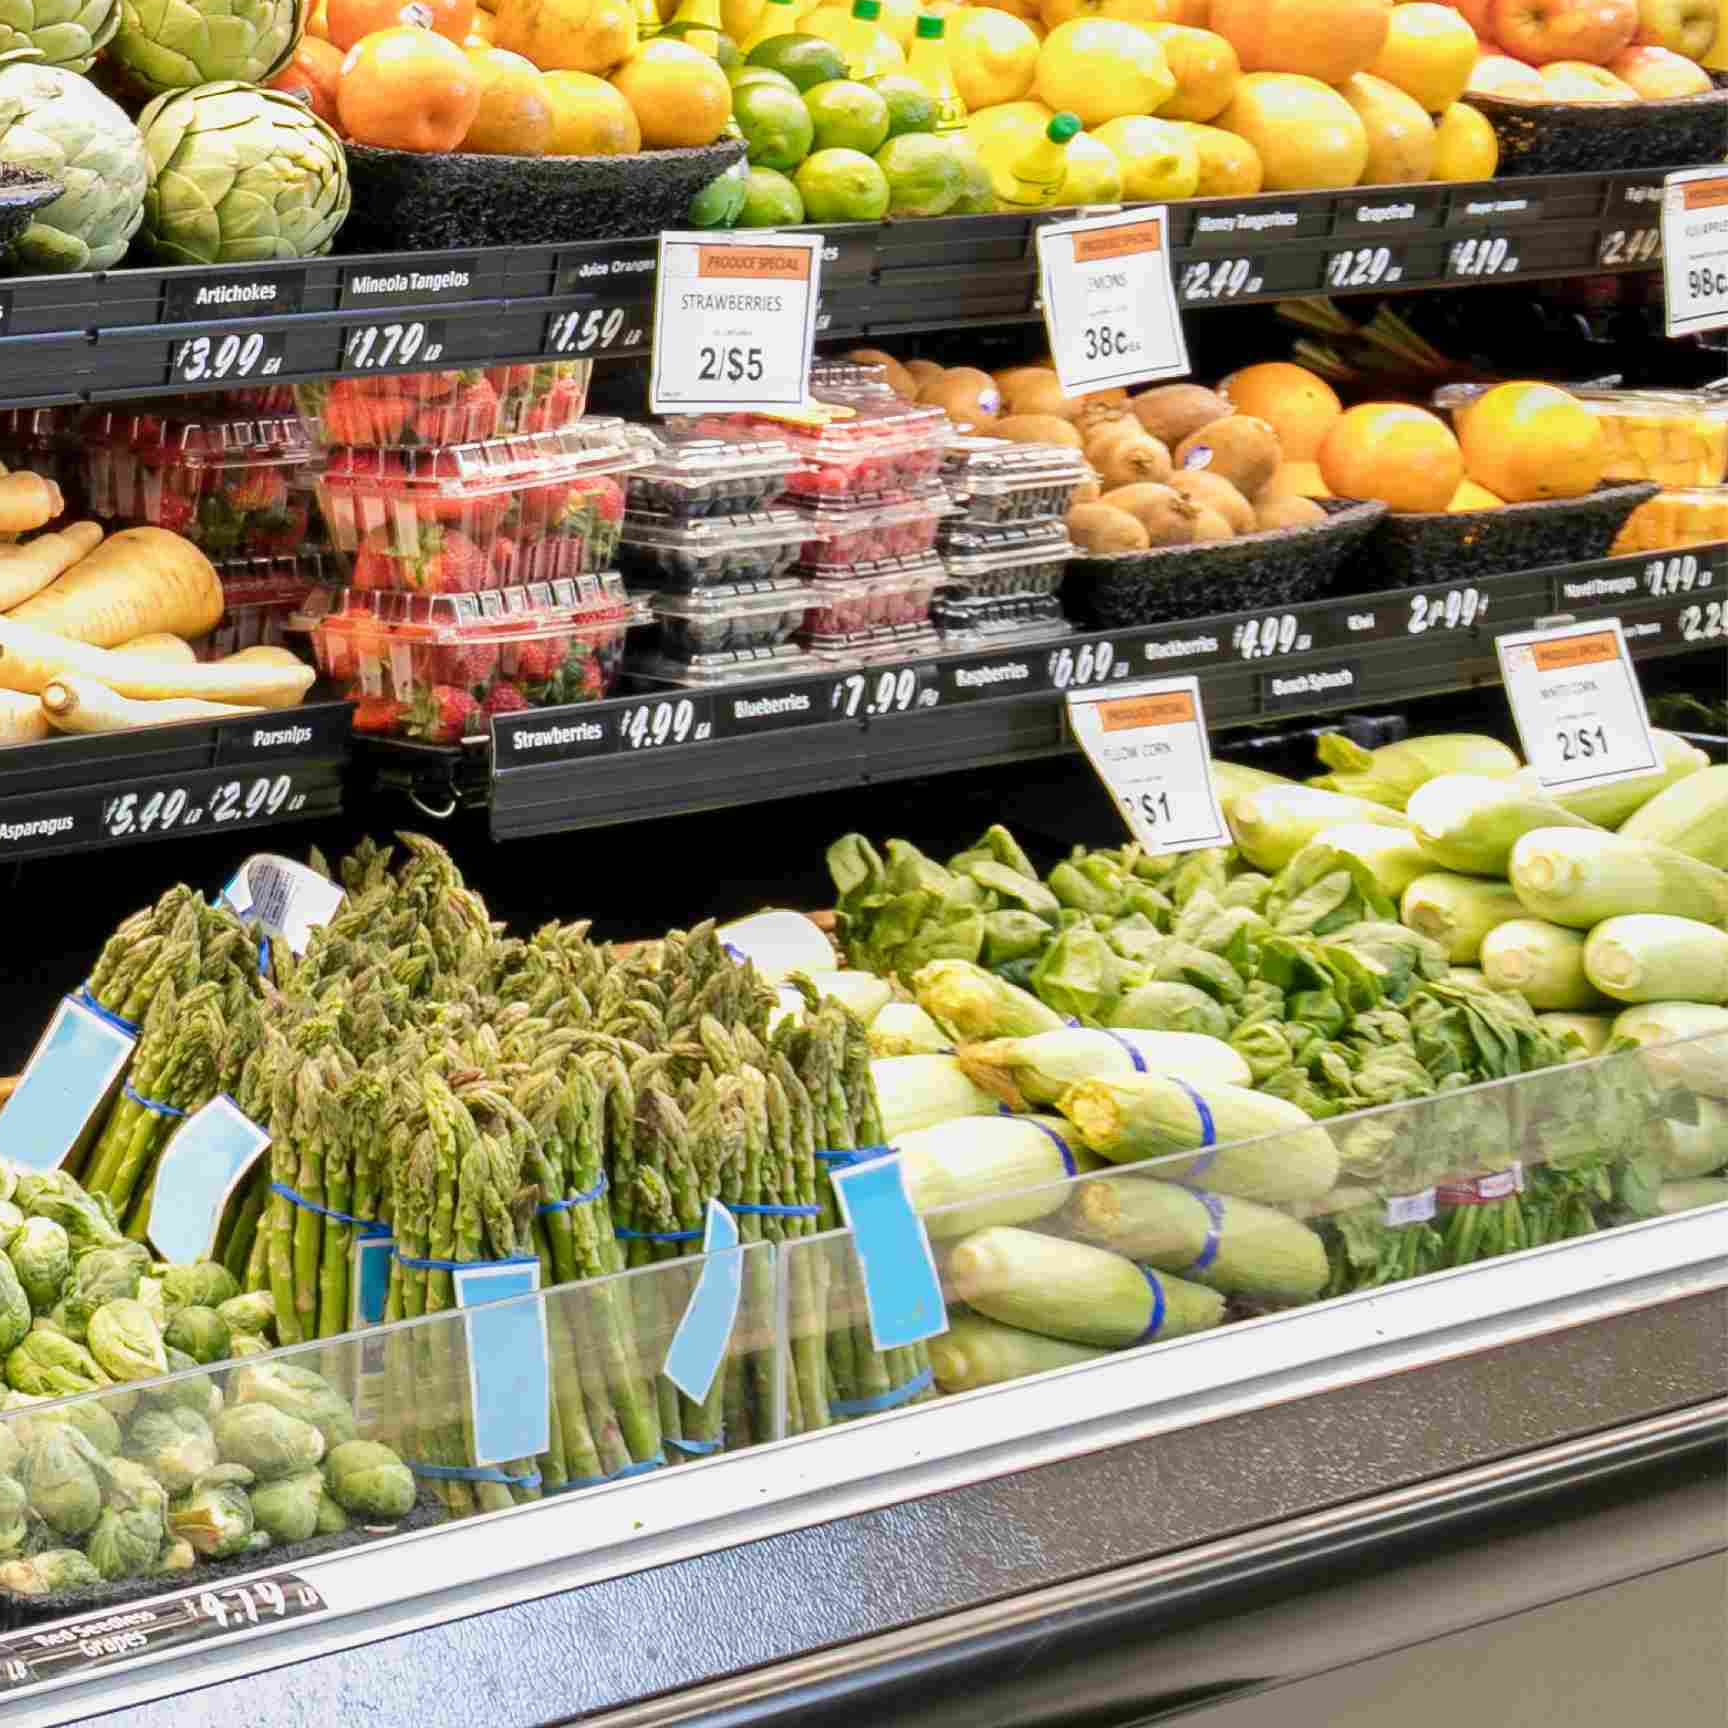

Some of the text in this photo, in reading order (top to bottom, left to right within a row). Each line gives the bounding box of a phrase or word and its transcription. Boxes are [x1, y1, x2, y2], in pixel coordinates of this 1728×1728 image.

[196, 283, 276, 304] Artichokes
[352, 271, 469, 294] Mineola Tangelos
[682, 294, 781, 312] STRAWBERRIES
[177, 333, 263, 380] $3.99
[349, 323, 424, 368] $1.79
[699, 348, 763, 381] 2/$5
[734, 693, 810, 718] Blueberries
[253, 726, 312, 747] Parsnips
[513, 723, 602, 749] Strawberries
[105, 789, 186, 836] $5.49
[209, 775, 291, 822] $2.99
[74, 1609, 157, 1640] Seedless
[78, 1631, 148, 1661] Grapes
